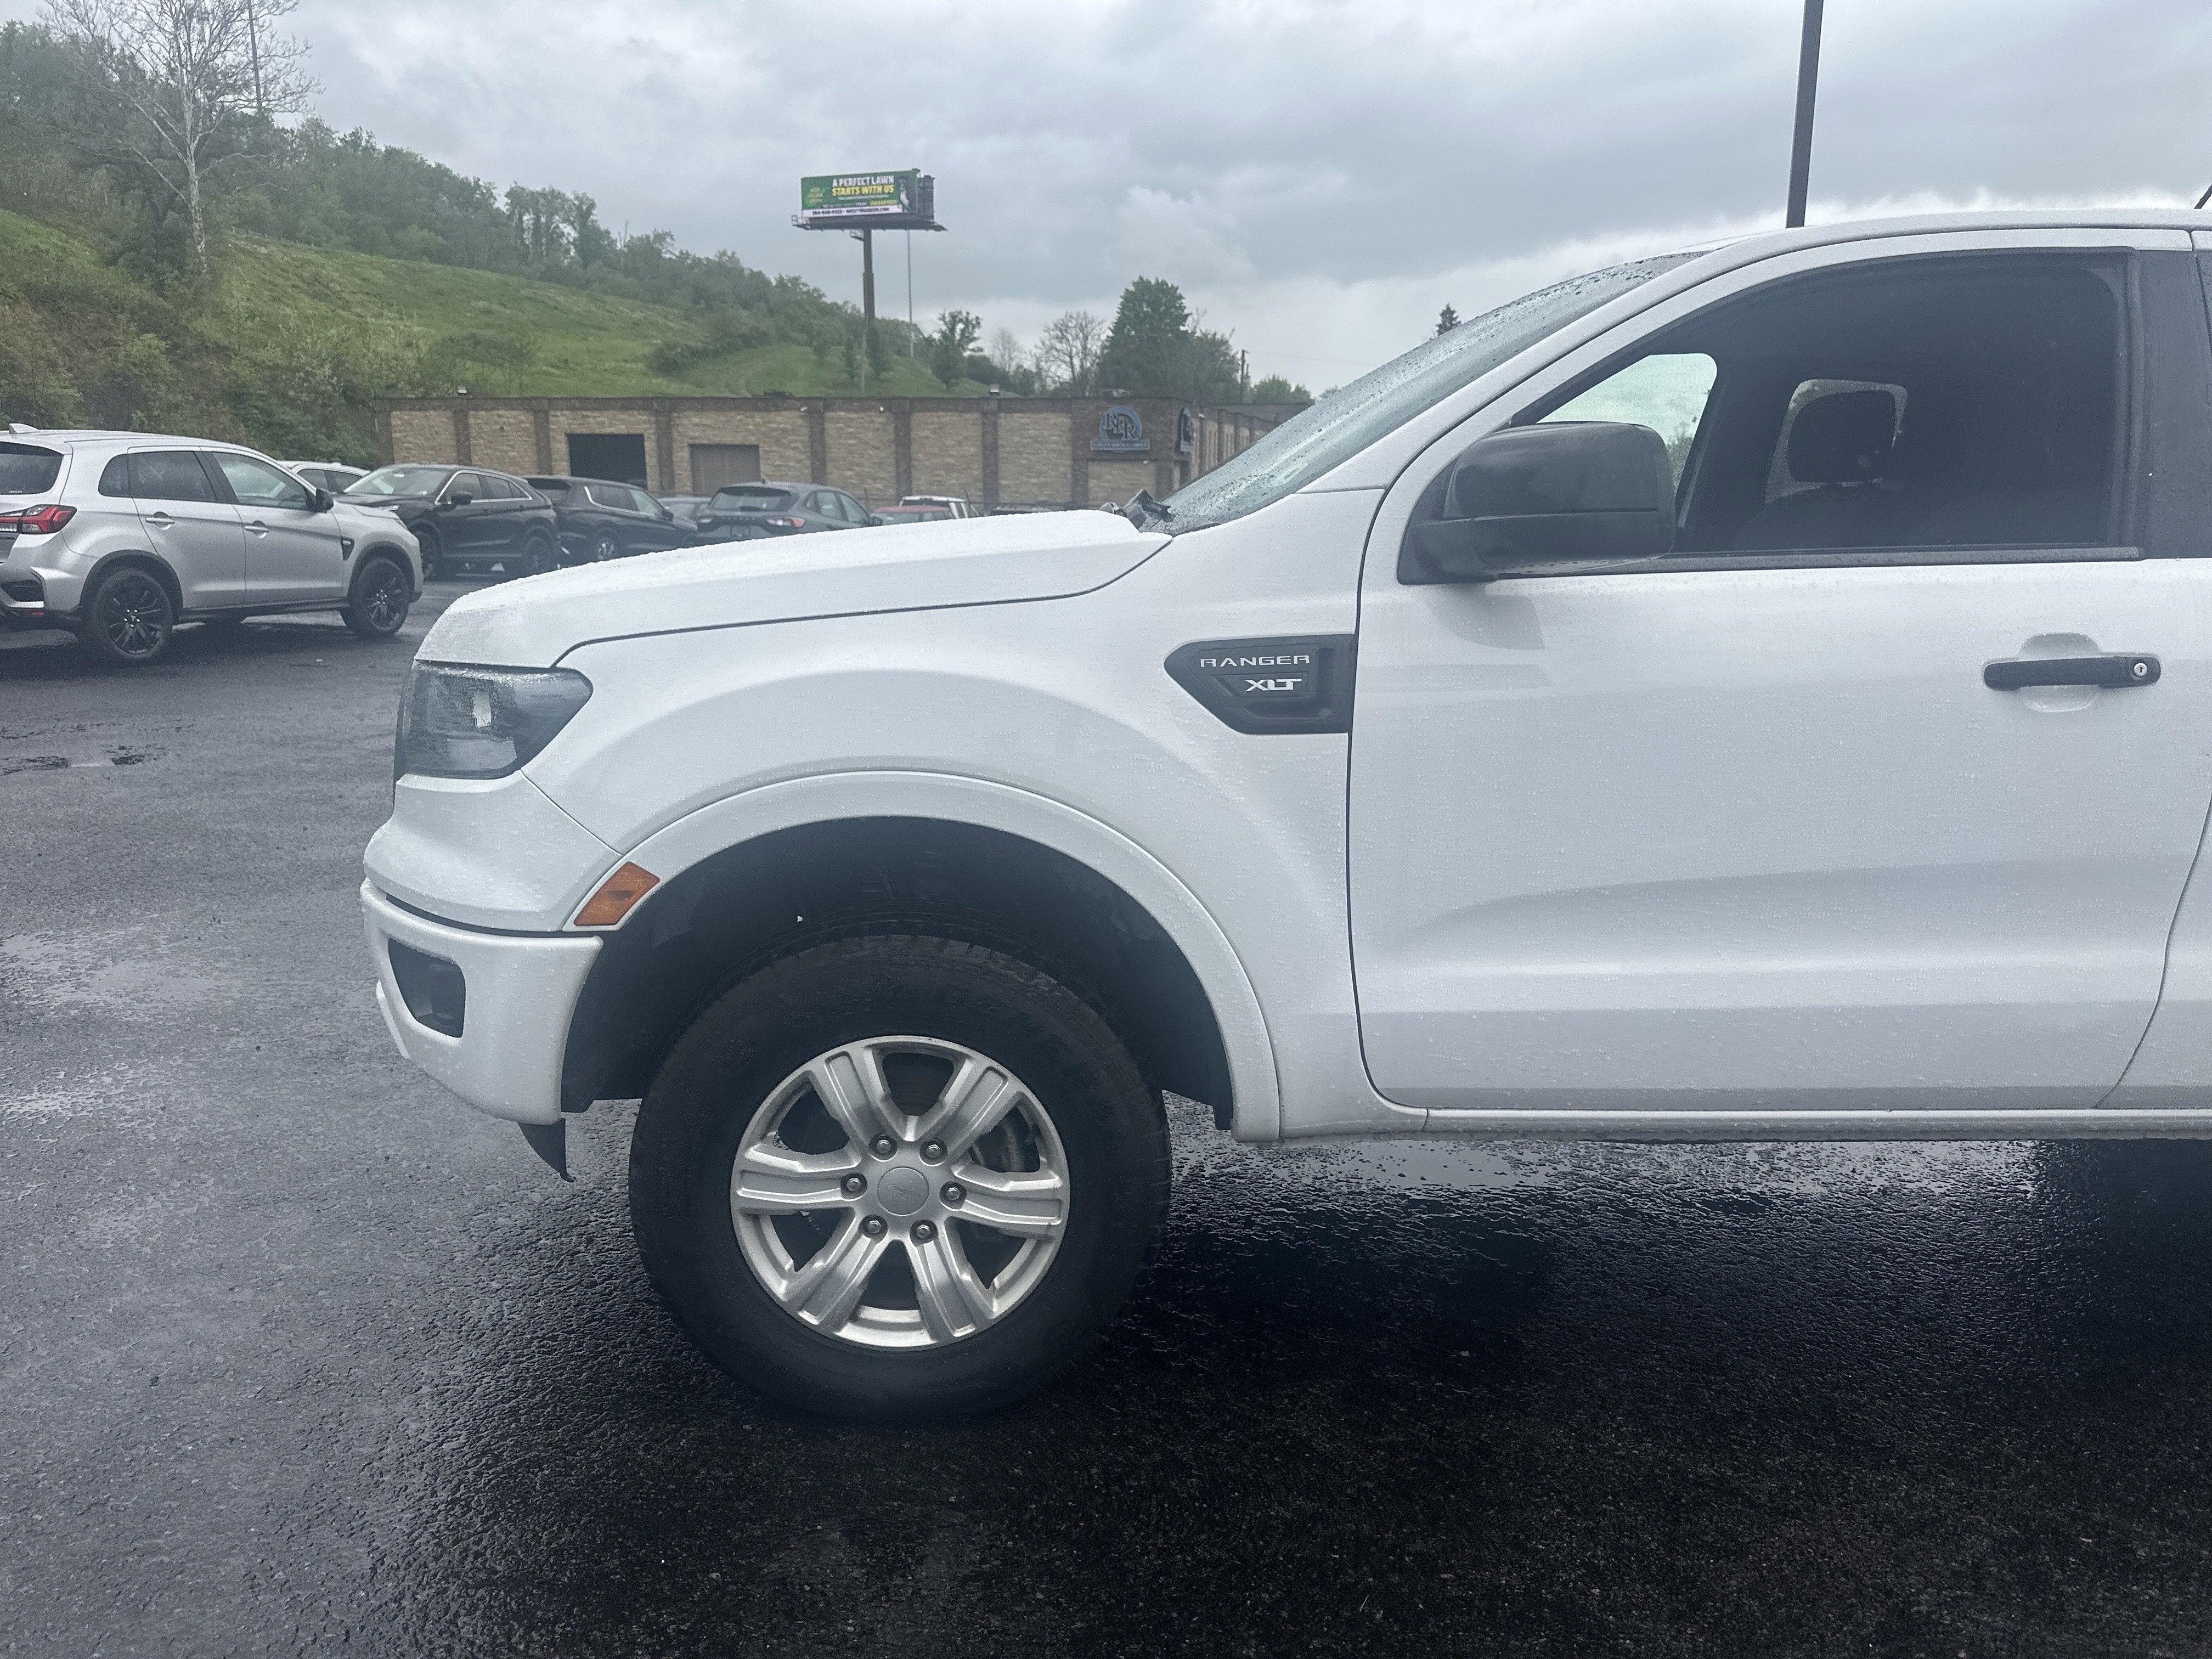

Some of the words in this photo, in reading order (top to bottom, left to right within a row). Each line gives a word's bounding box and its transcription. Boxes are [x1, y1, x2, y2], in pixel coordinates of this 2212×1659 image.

[839, 177, 870, 187] PERFECT
[872, 176, 894, 185] LAWN
[832, 186, 860, 196] STARTS
[861, 185, 883, 195] WITH
[884, 184, 894, 193] US
[1200, 655, 1310, 667] RANGER
[1245, 678, 1302, 692] XLT
